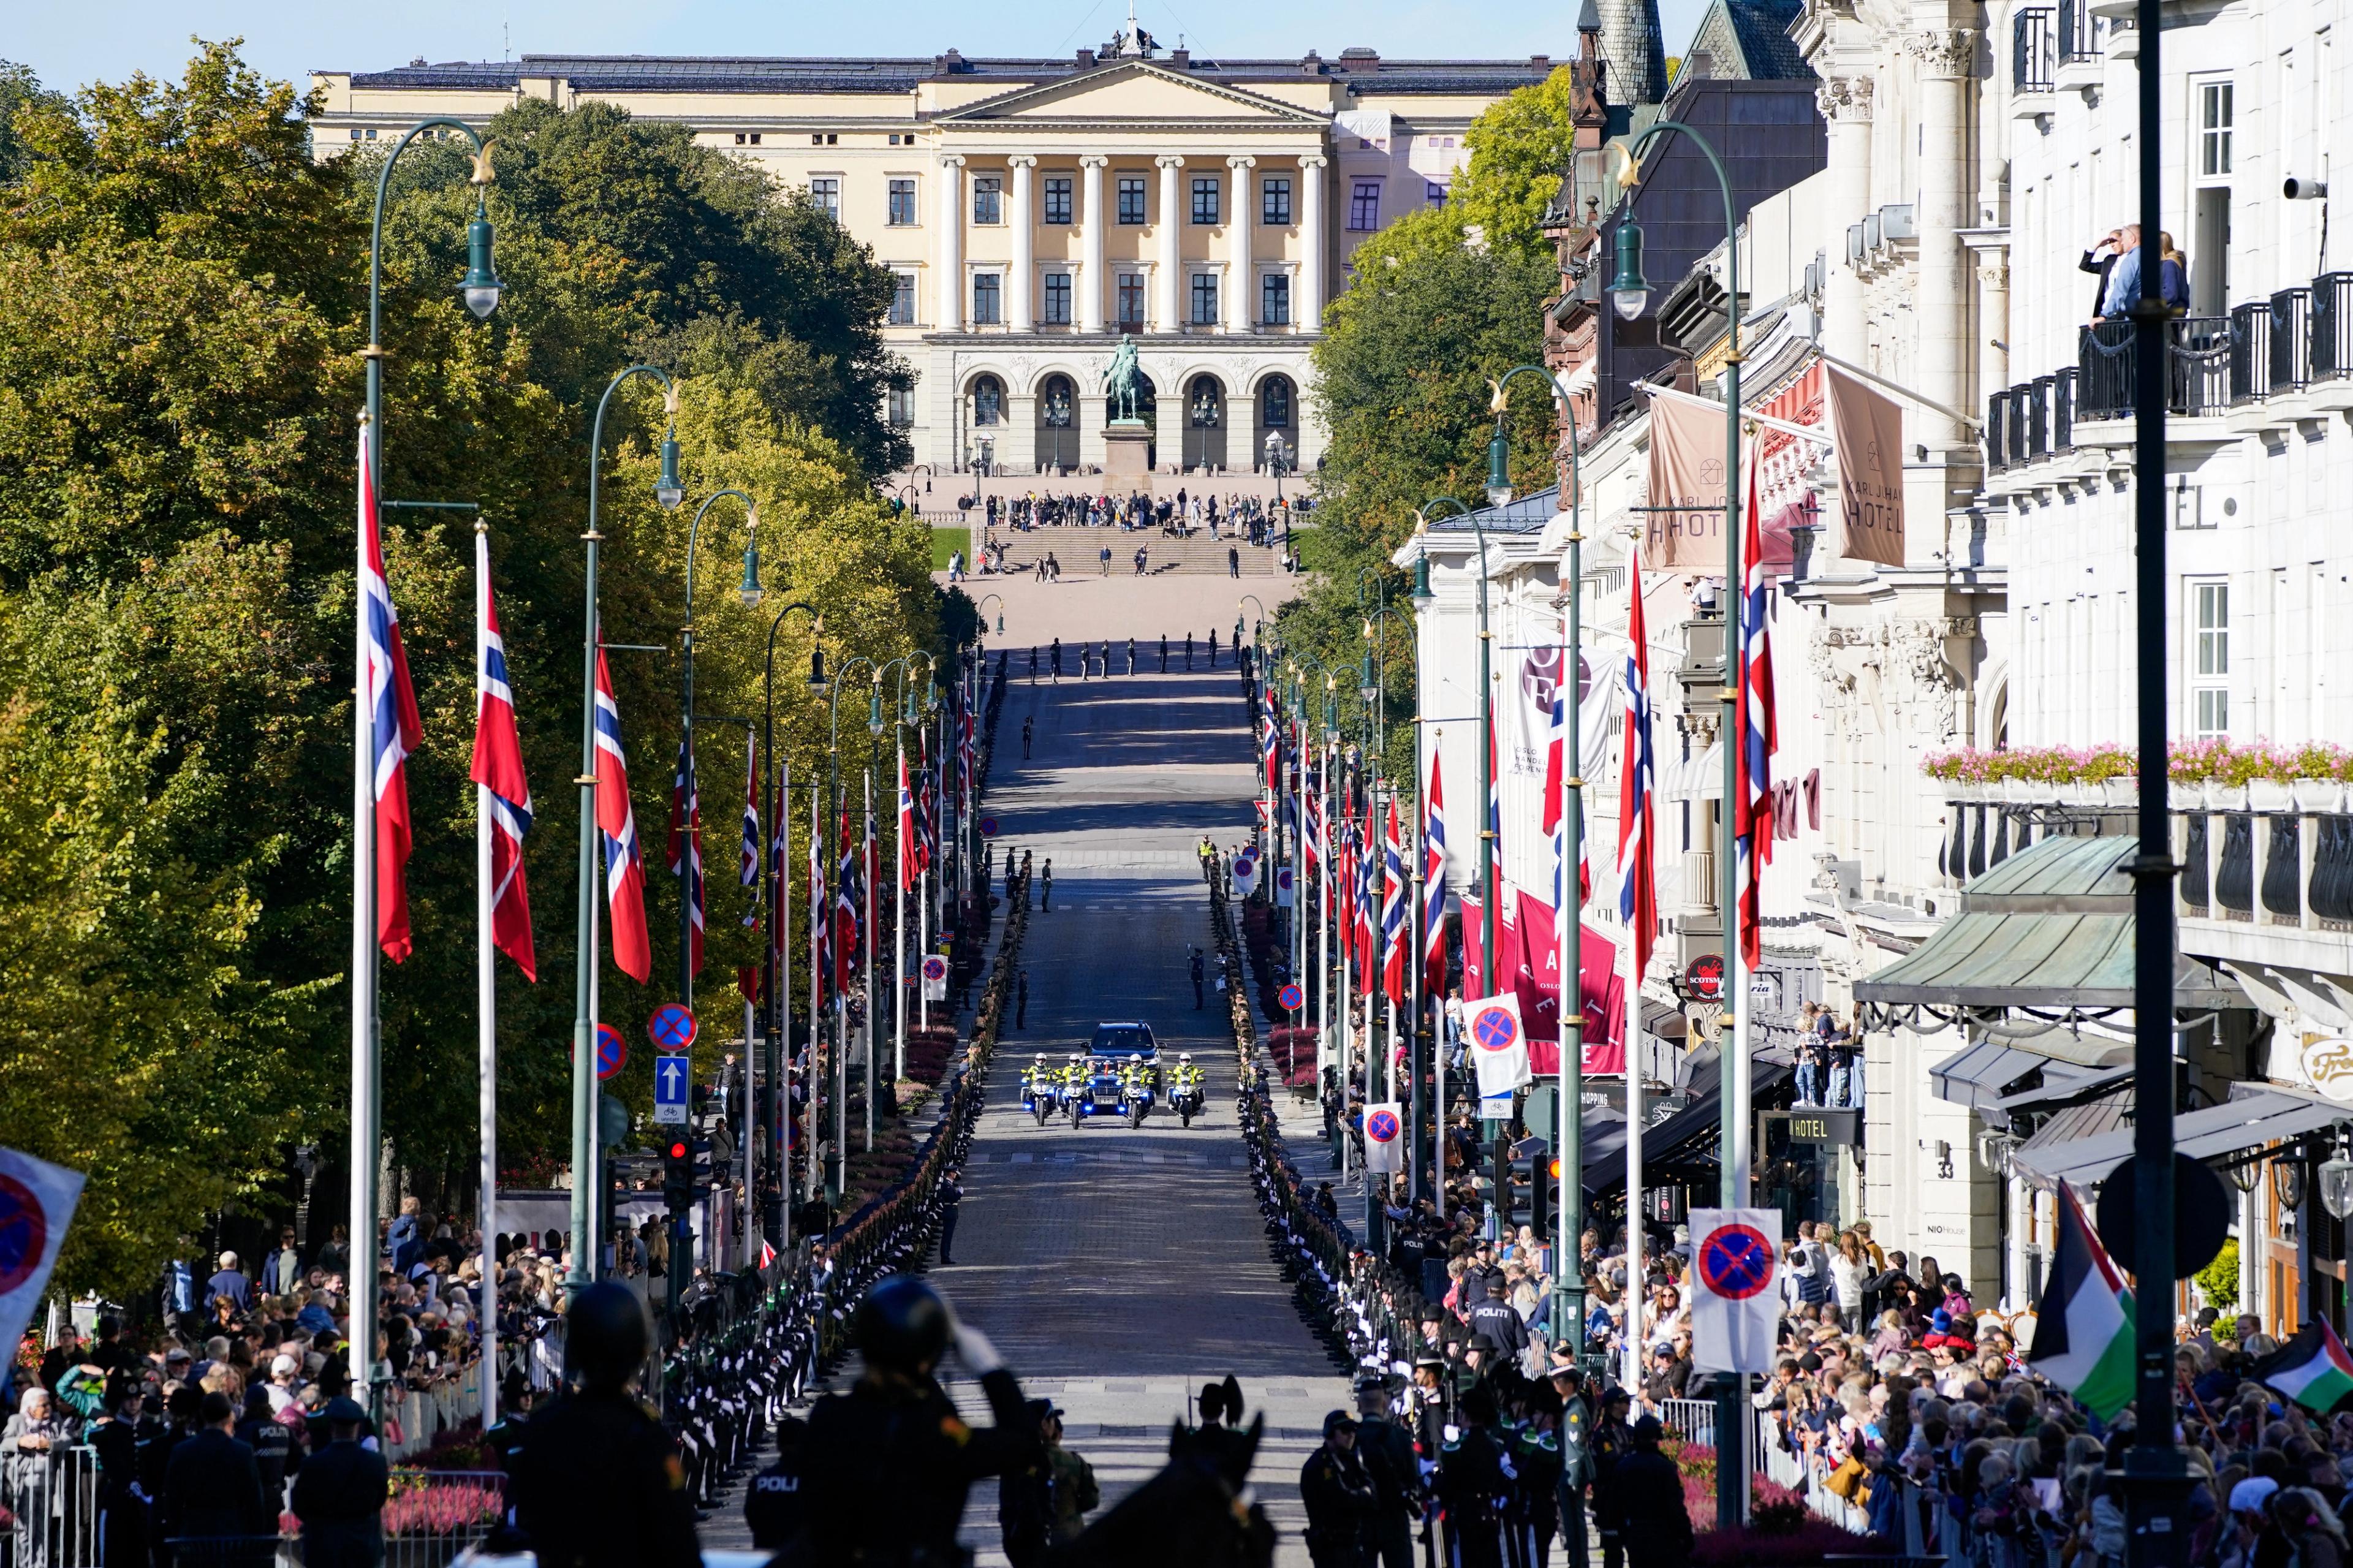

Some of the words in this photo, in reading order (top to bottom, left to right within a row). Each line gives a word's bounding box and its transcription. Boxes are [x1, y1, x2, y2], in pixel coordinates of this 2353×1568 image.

[1846, 481, 1873, 496] KARL
[1669, 496, 1700, 507] KARL
[1710, 496, 1745, 507] JOA
[1847, 501, 1902, 533] HOTEL
[1670, 513, 1721, 537] HOT
[1516, 746, 1537, 755] OSLO
[1581, 1092, 1608, 1105] HOPPING
[1795, 1119, 1827, 1137] HOTEL
[1938, 1161, 1953, 1179] 33
[1476, 1308, 1508, 1318] POLITI
[757, 1476, 798, 1491] POLI
